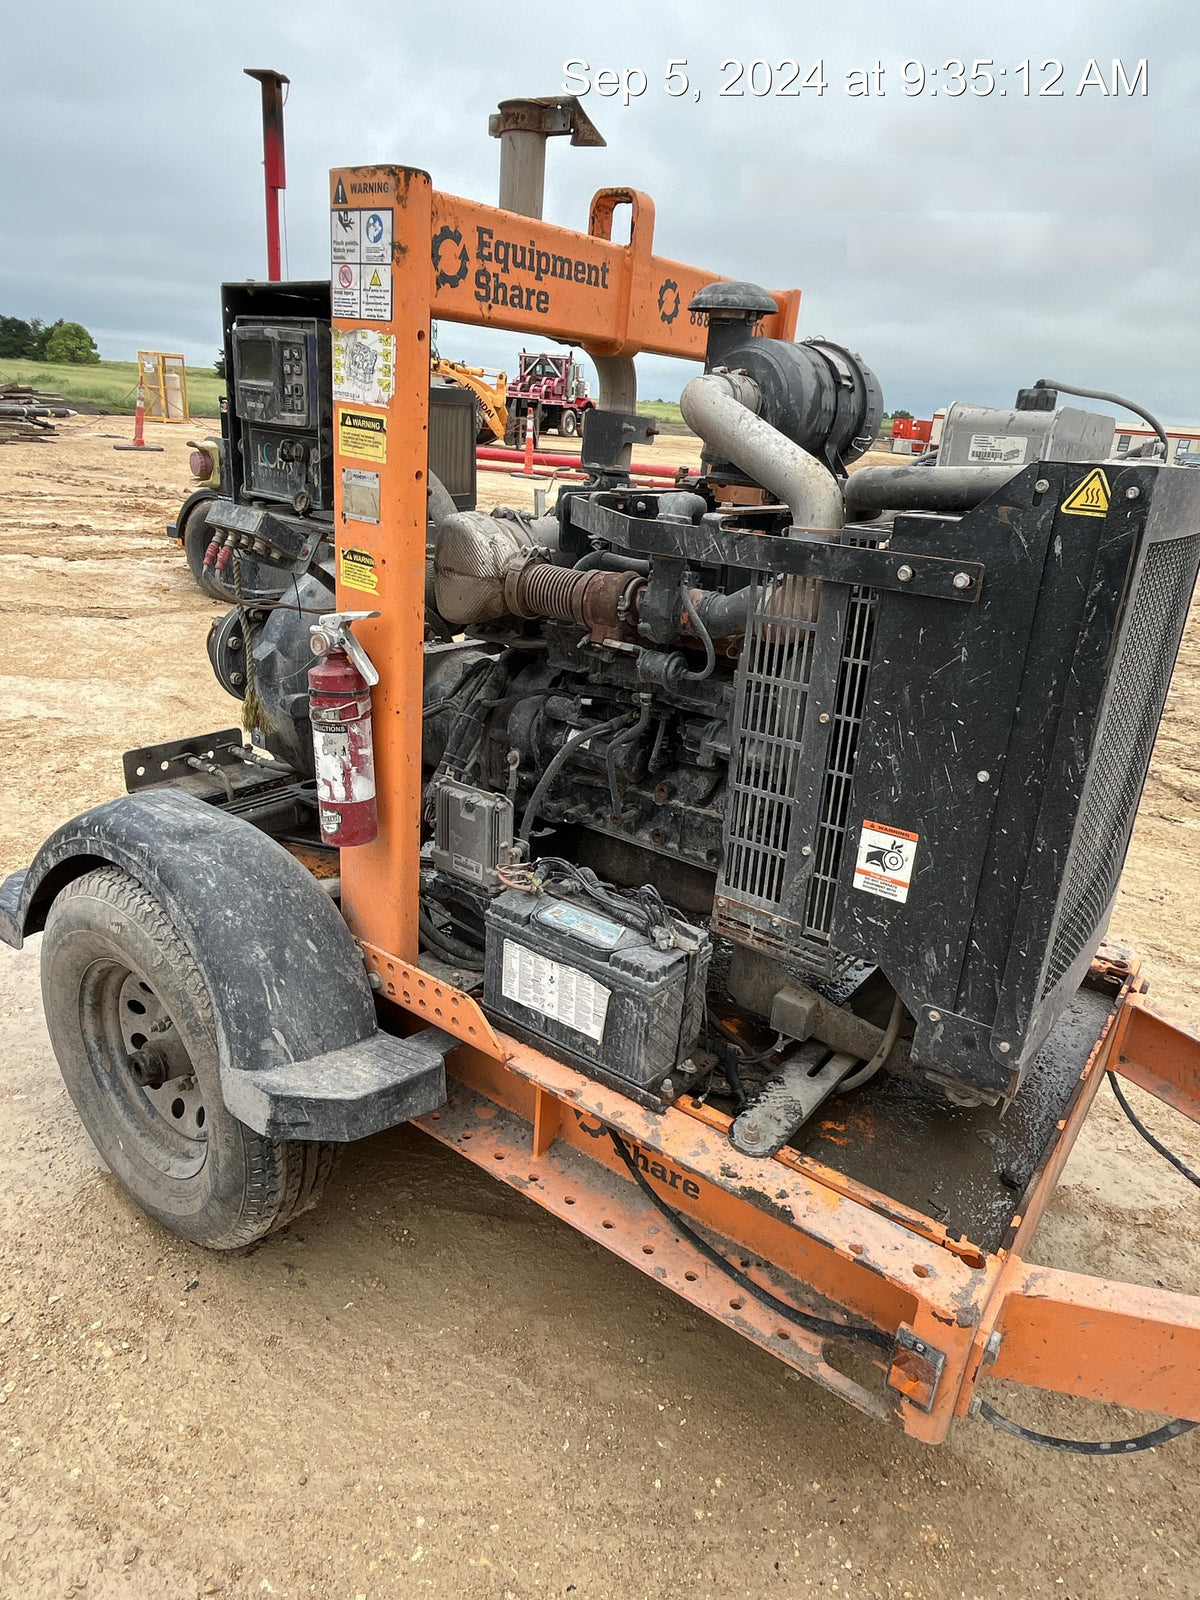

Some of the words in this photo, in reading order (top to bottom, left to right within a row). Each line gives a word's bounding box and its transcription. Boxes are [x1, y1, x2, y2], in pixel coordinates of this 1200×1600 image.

[350, 182, 389, 194] WARNING
[476, 226, 610, 289] Equipment
[474, 267, 550, 314] Share
[352, 418, 381, 430] WARNING
[878, 825, 910, 838] WARNING
